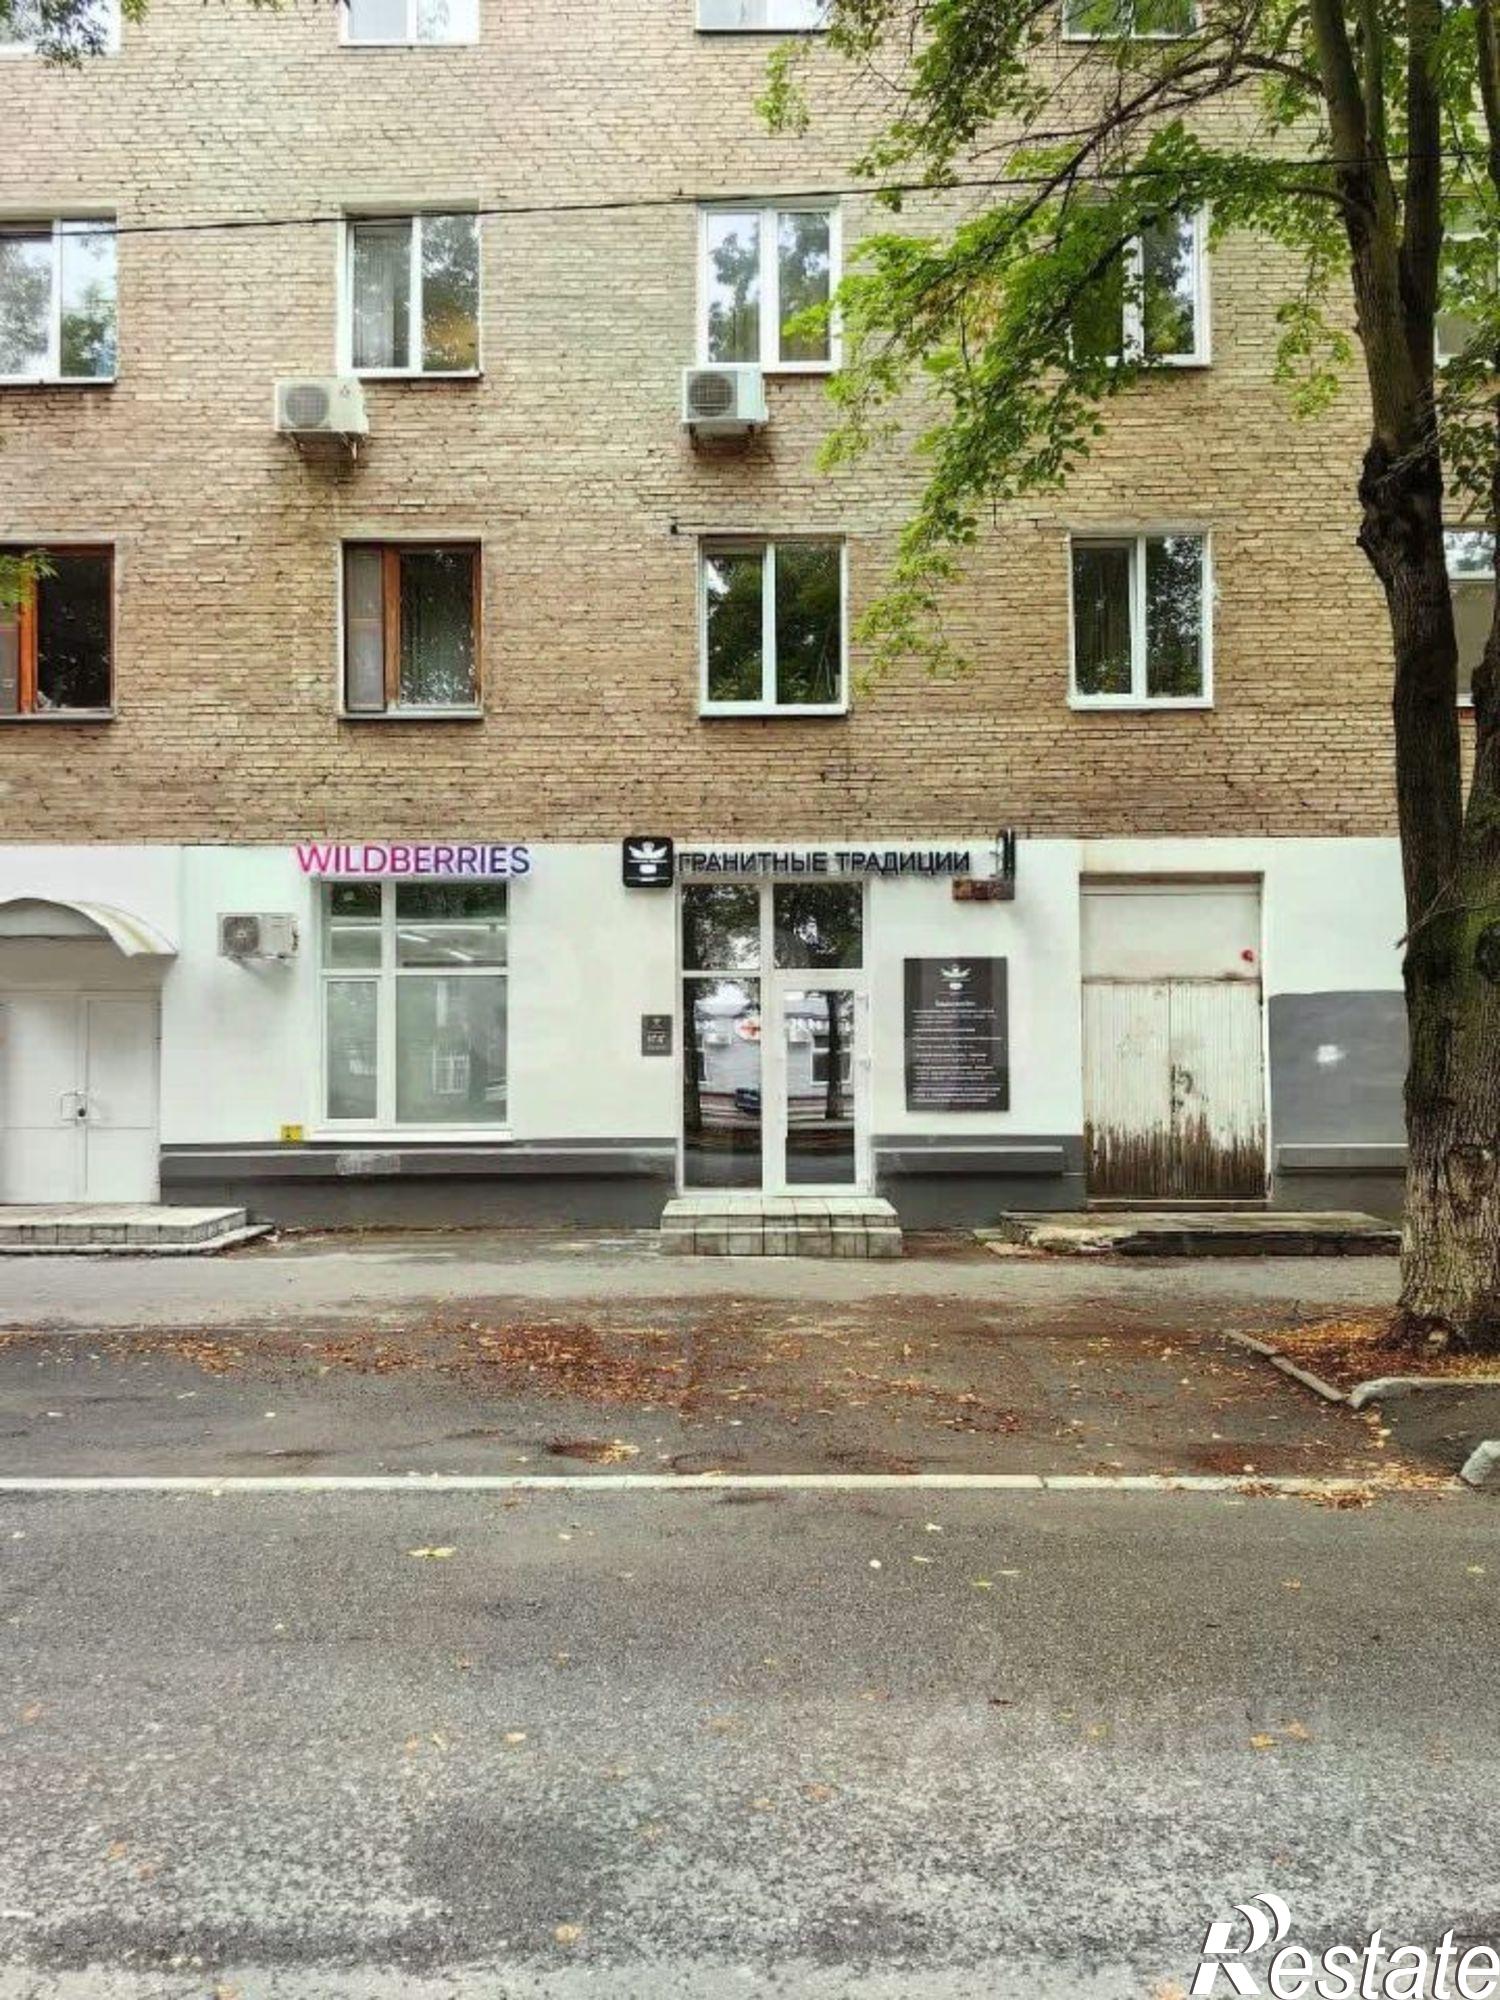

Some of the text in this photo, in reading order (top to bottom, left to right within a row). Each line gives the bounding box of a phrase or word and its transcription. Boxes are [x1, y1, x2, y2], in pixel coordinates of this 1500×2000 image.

[296, 845, 531, 874] WILDBERRIES
[678, 851, 971, 876] ГРАНИТНЫЕ ТРАДИЦИИ
